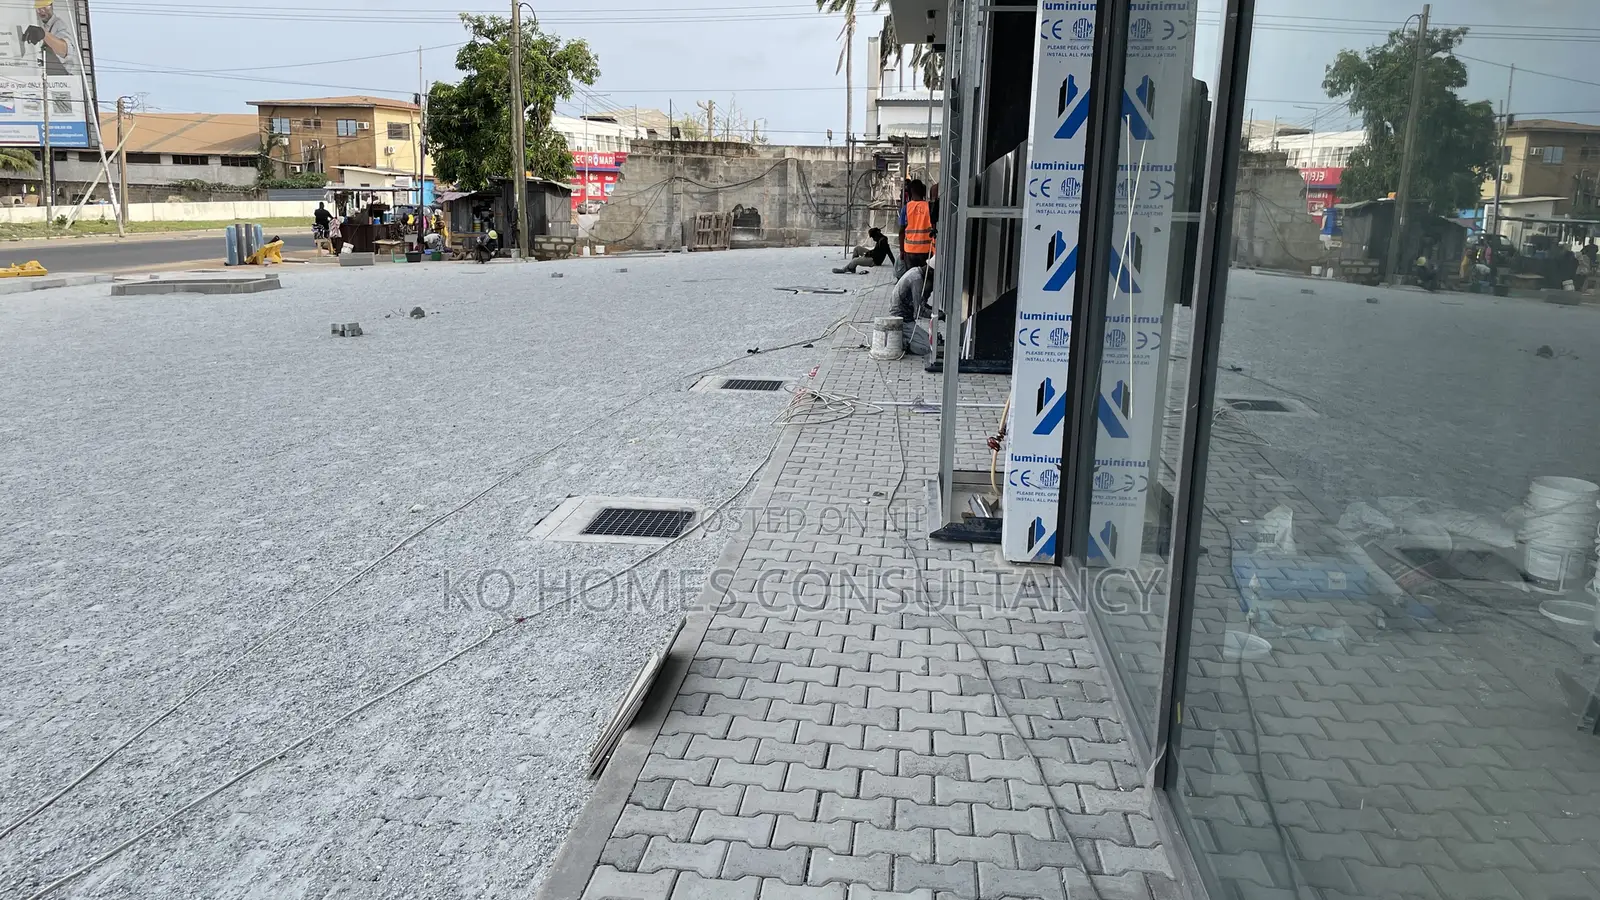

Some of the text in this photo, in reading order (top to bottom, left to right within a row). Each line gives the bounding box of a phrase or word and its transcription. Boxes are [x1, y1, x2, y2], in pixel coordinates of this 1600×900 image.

[1072, 18, 1094, 38] ASTM
[1060, 177, 1081, 196] ASTM
[1018, 327, 1069, 347] CE ASTM
[1010, 469, 1059, 487] CE ASTM
